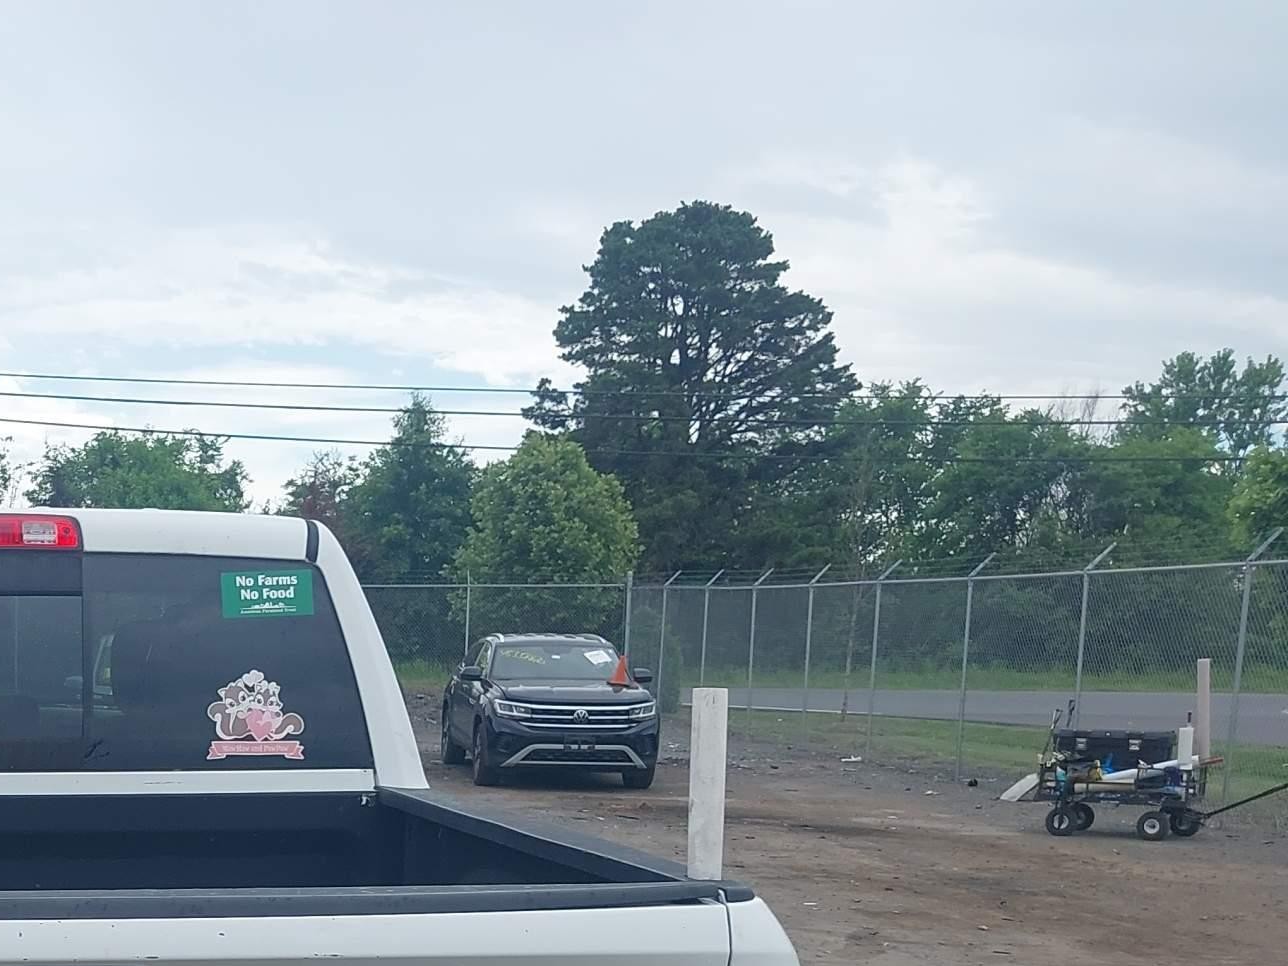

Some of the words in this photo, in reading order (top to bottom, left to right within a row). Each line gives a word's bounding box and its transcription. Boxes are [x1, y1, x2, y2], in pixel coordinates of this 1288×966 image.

[235, 576, 254, 587] No
[257, 575, 298, 586] Farms
[240, 589, 259, 600] No
[262, 586, 295, 599] Food
